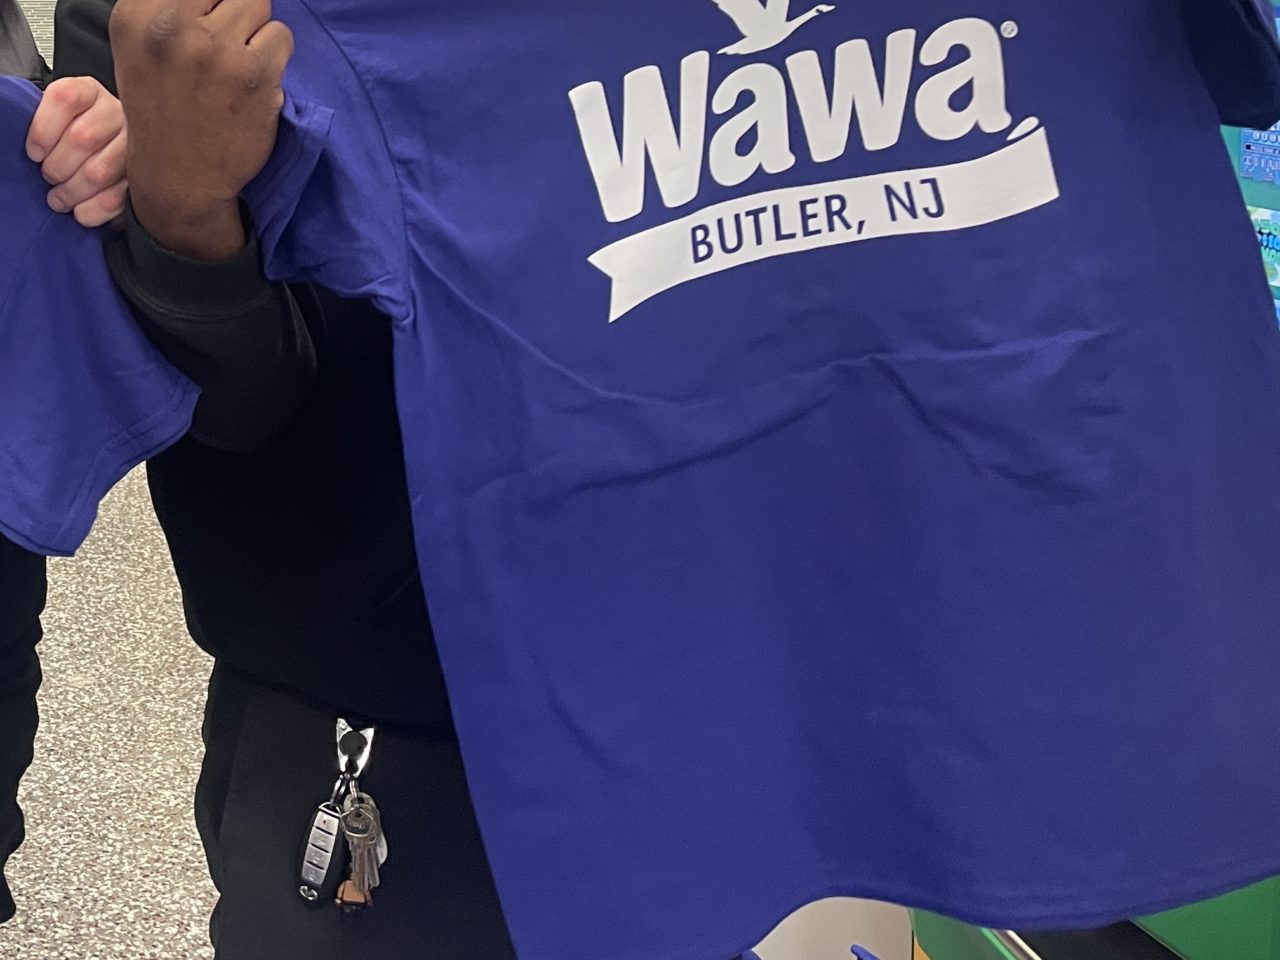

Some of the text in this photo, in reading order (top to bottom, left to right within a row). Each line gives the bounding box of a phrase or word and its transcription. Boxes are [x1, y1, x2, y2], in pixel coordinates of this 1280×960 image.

[568, 17, 1012, 223] Wawa
[690, 177, 946, 265] BUTLER, NJ
